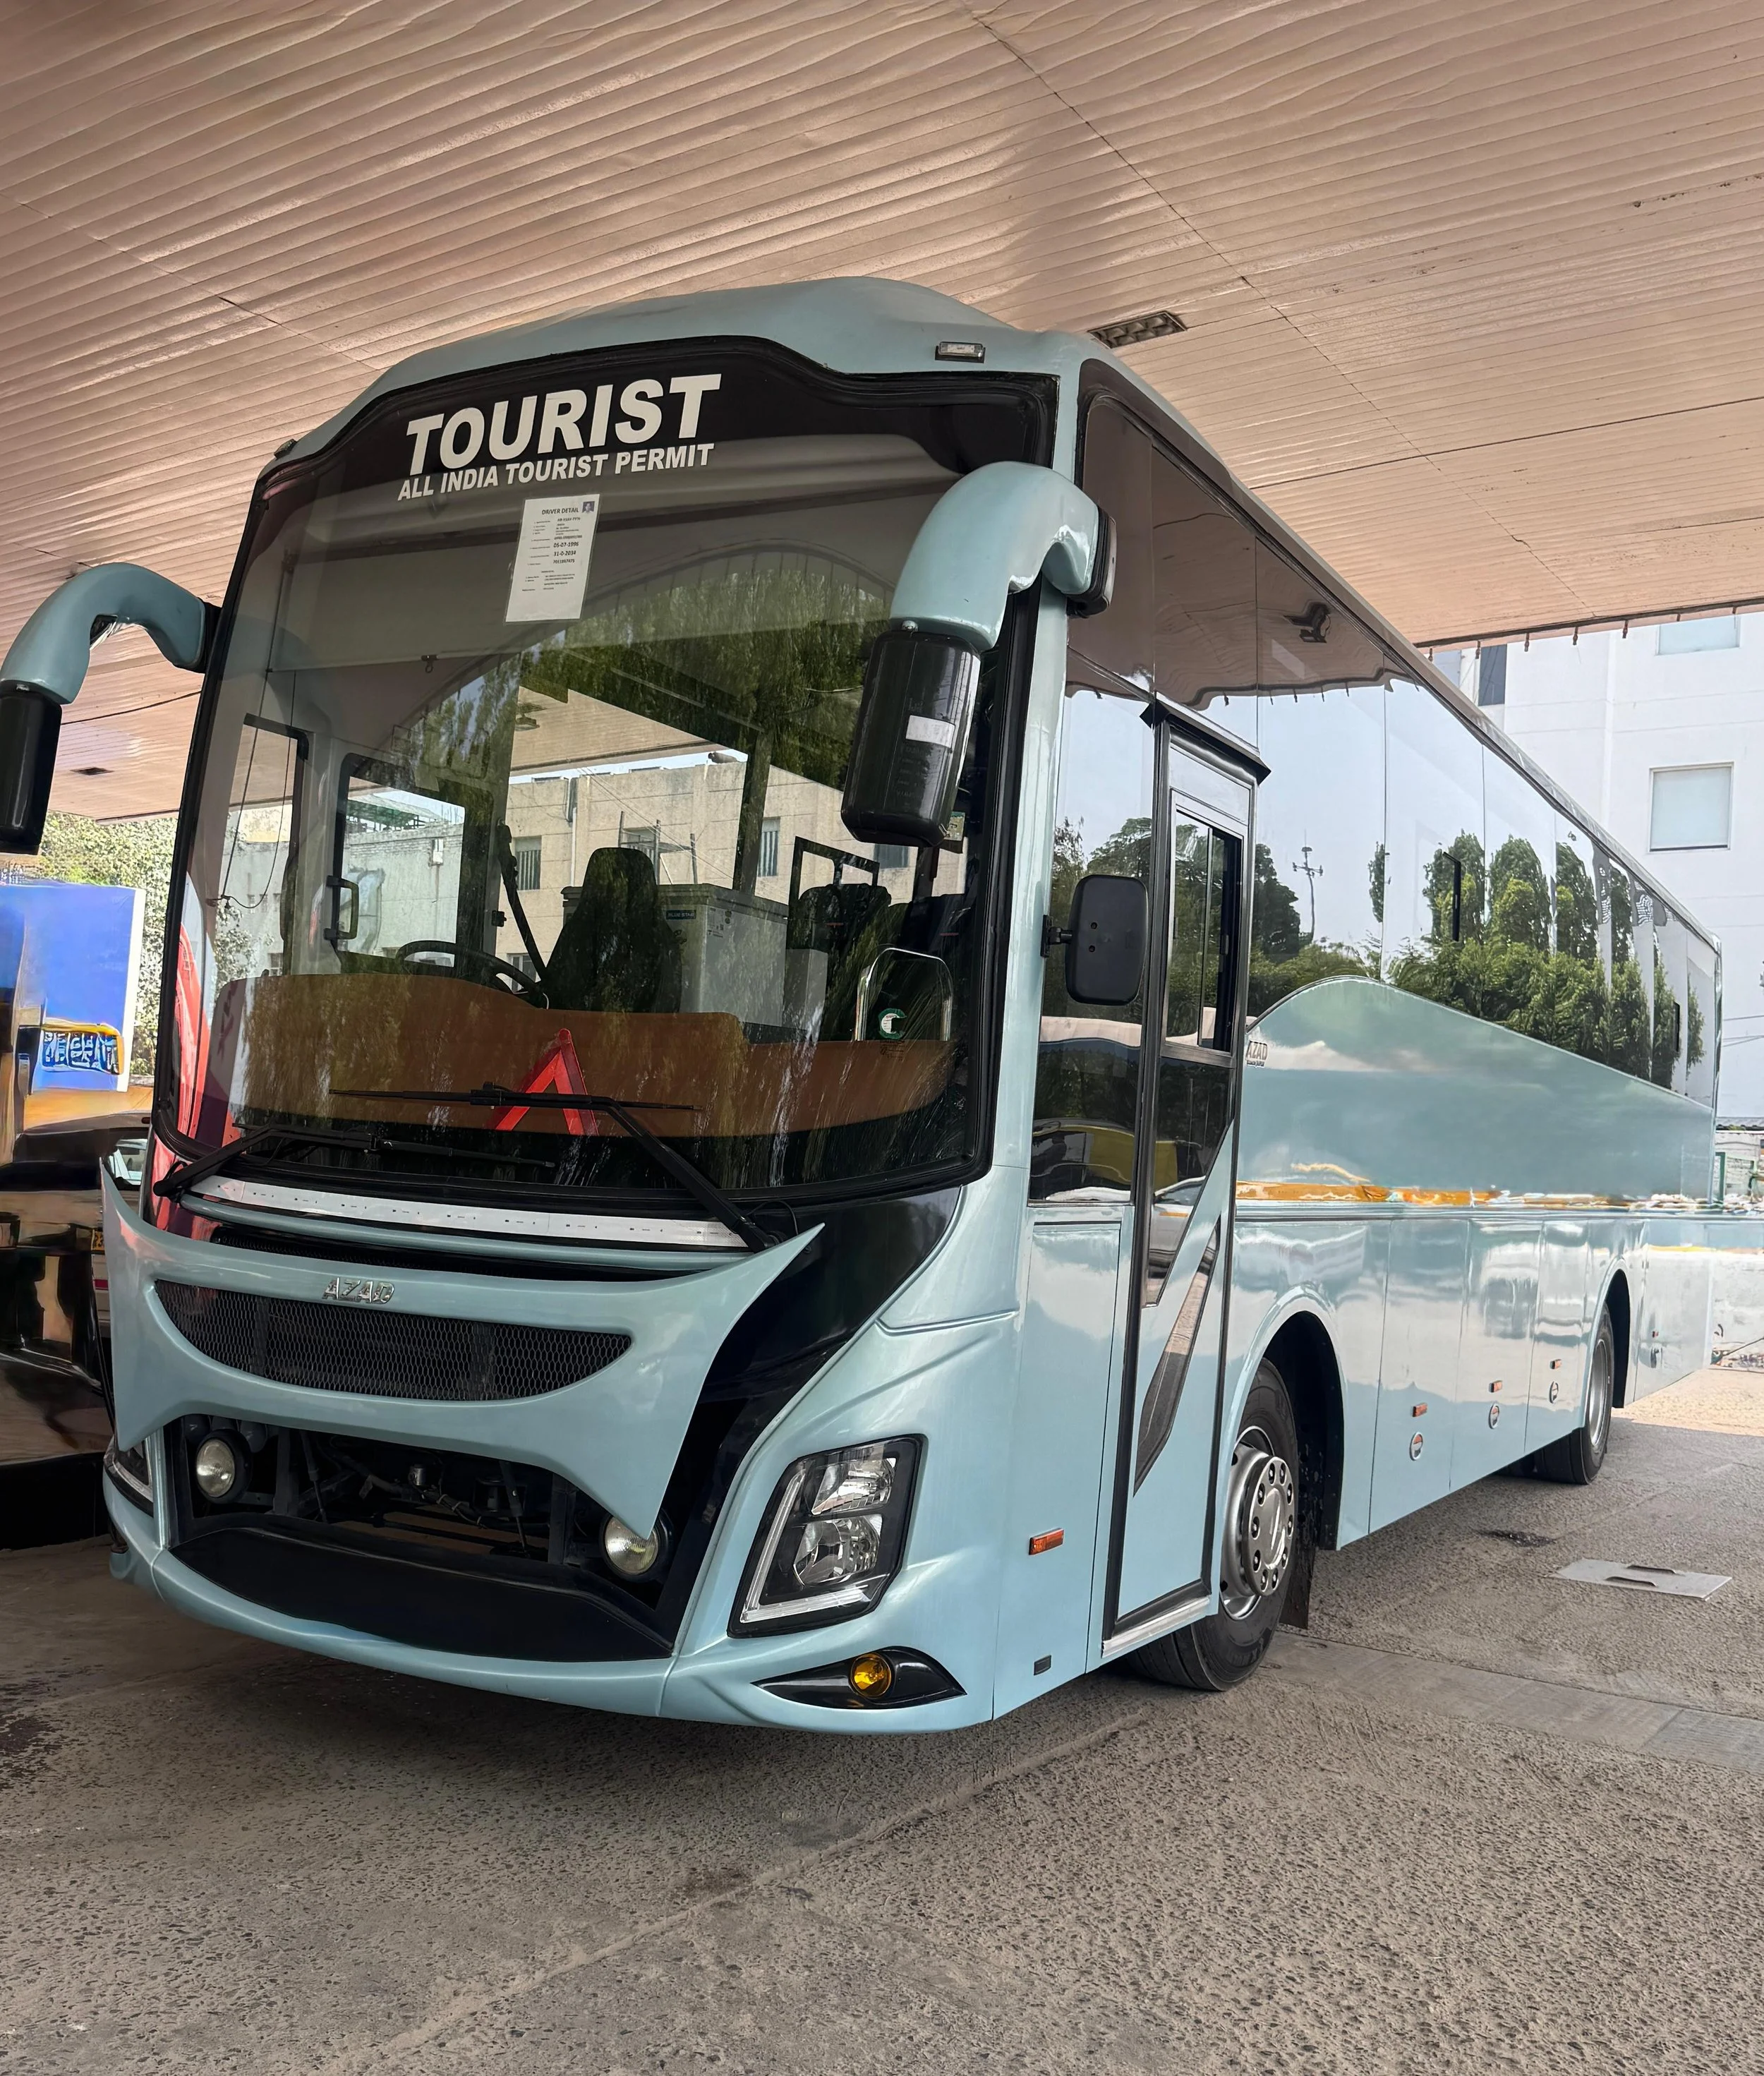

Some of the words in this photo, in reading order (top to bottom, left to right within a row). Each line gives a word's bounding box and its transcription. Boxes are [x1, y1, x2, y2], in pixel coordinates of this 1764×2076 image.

[406, 373, 721, 476] TOURIST
[397, 476, 434, 501] ALL
[440, 466, 498, 493] INDIA
[506, 454, 609, 485] TOURIST
[615, 443, 715, 474] PERMIT
[1245, 1040, 1268, 1061] AZAD
[322, 1277, 395, 1305] AZAD
